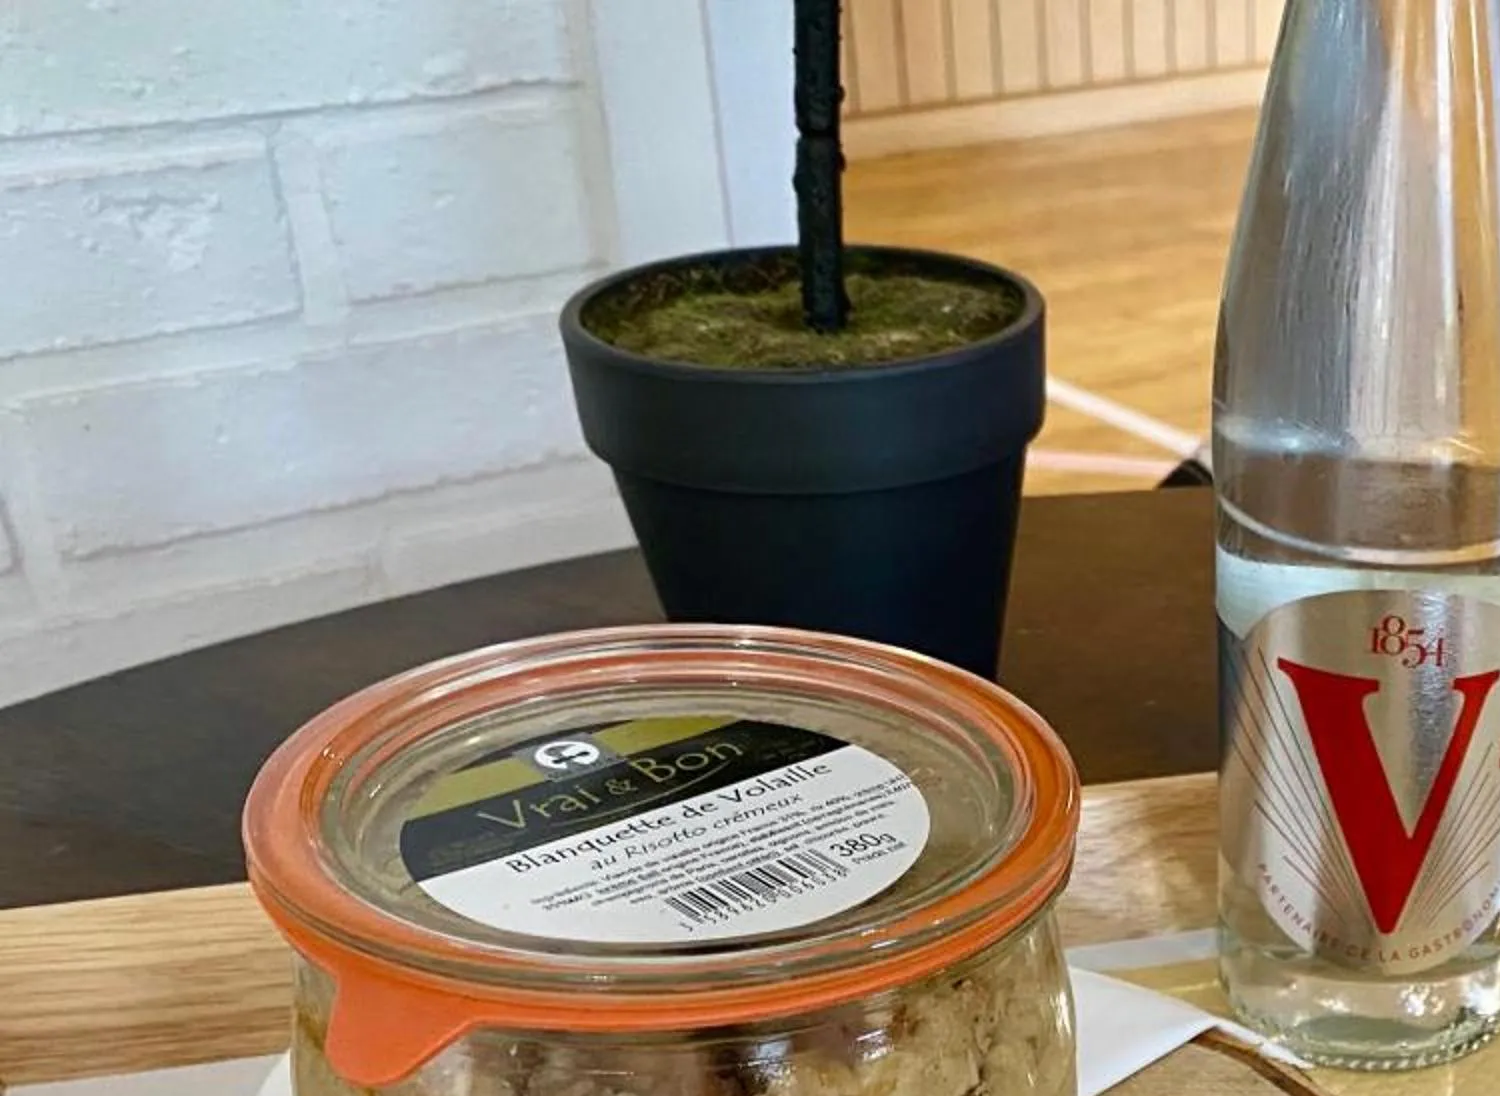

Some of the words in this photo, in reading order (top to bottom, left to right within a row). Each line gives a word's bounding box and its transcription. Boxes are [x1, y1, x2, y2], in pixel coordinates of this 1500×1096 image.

[1369, 615, 1445, 669] 1854
[477, 785, 601, 830] Vrai
[604, 778, 638, 796] &
[629, 741, 744, 783] Bon
[505, 813, 677, 874] Blanquette
[683, 800, 718, 821] de
[717, 761, 833, 804] Volaille
[591, 855, 617, 872] au
[625, 825, 708, 859] Risotto
[713, 793, 804, 830] crémeux
[829, 833, 897, 857] 380g
[1378, 950, 1401, 963] LA
